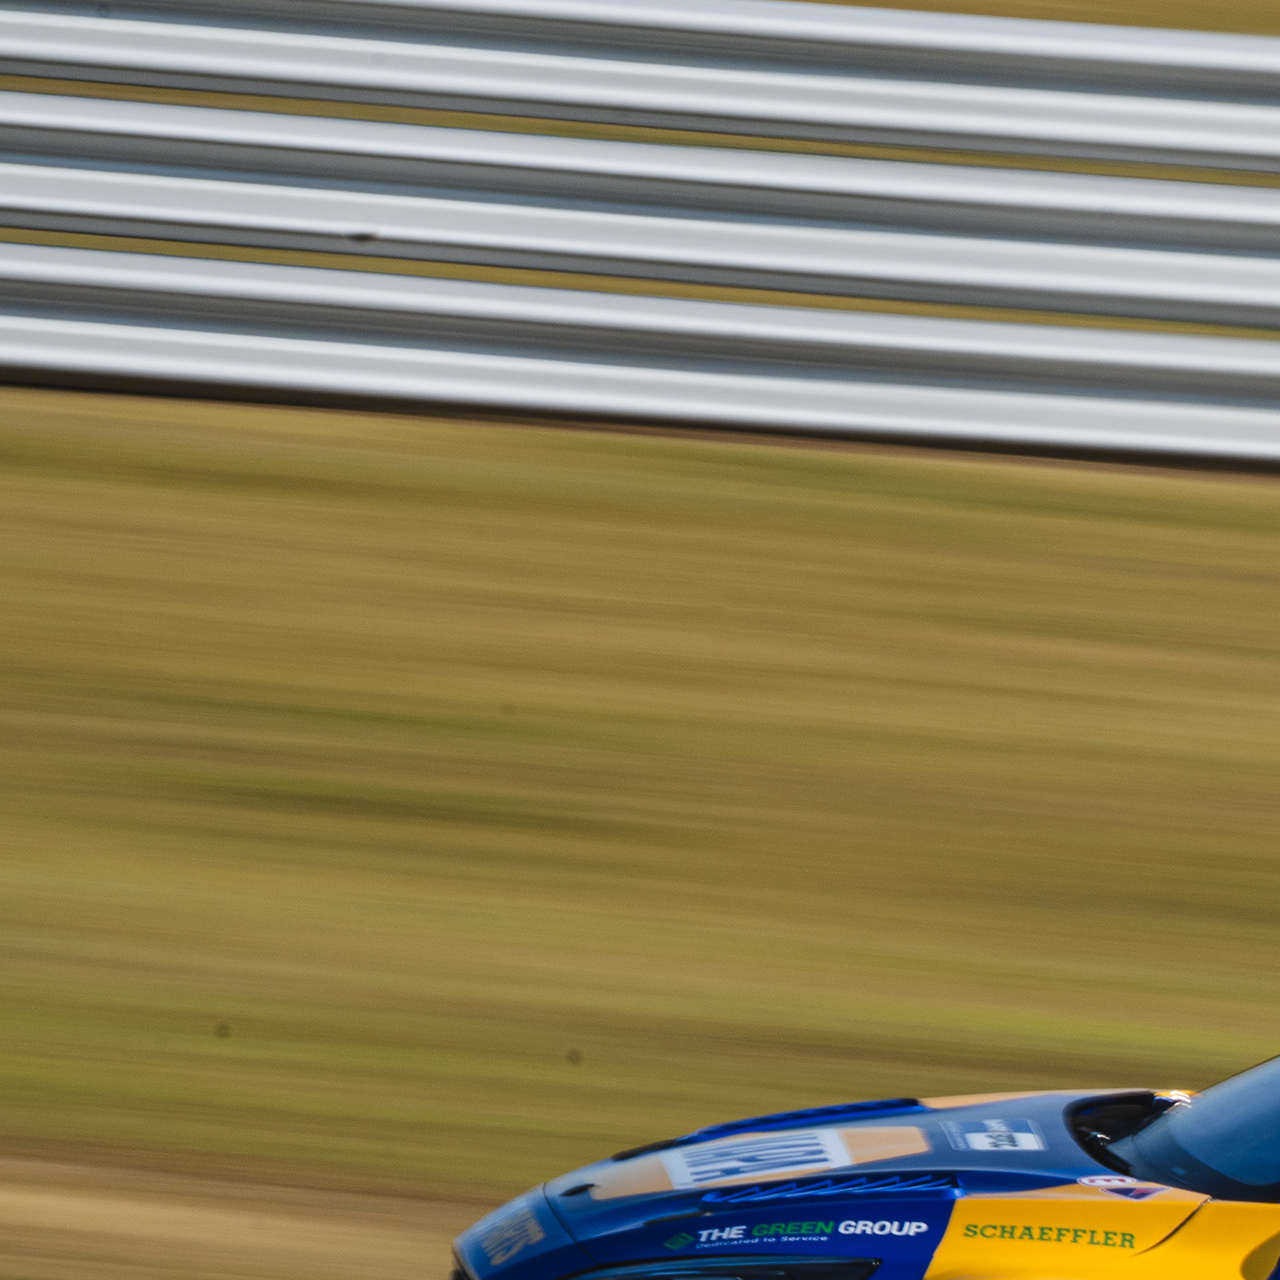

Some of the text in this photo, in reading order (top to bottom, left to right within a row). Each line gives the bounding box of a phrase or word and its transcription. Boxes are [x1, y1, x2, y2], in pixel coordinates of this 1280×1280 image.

[697, 1219, 930, 1243] THE GREEN GROUP
[780, 1234, 829, 1243] Service
[963, 1222, 1136, 1250] SCHAEFFLER
